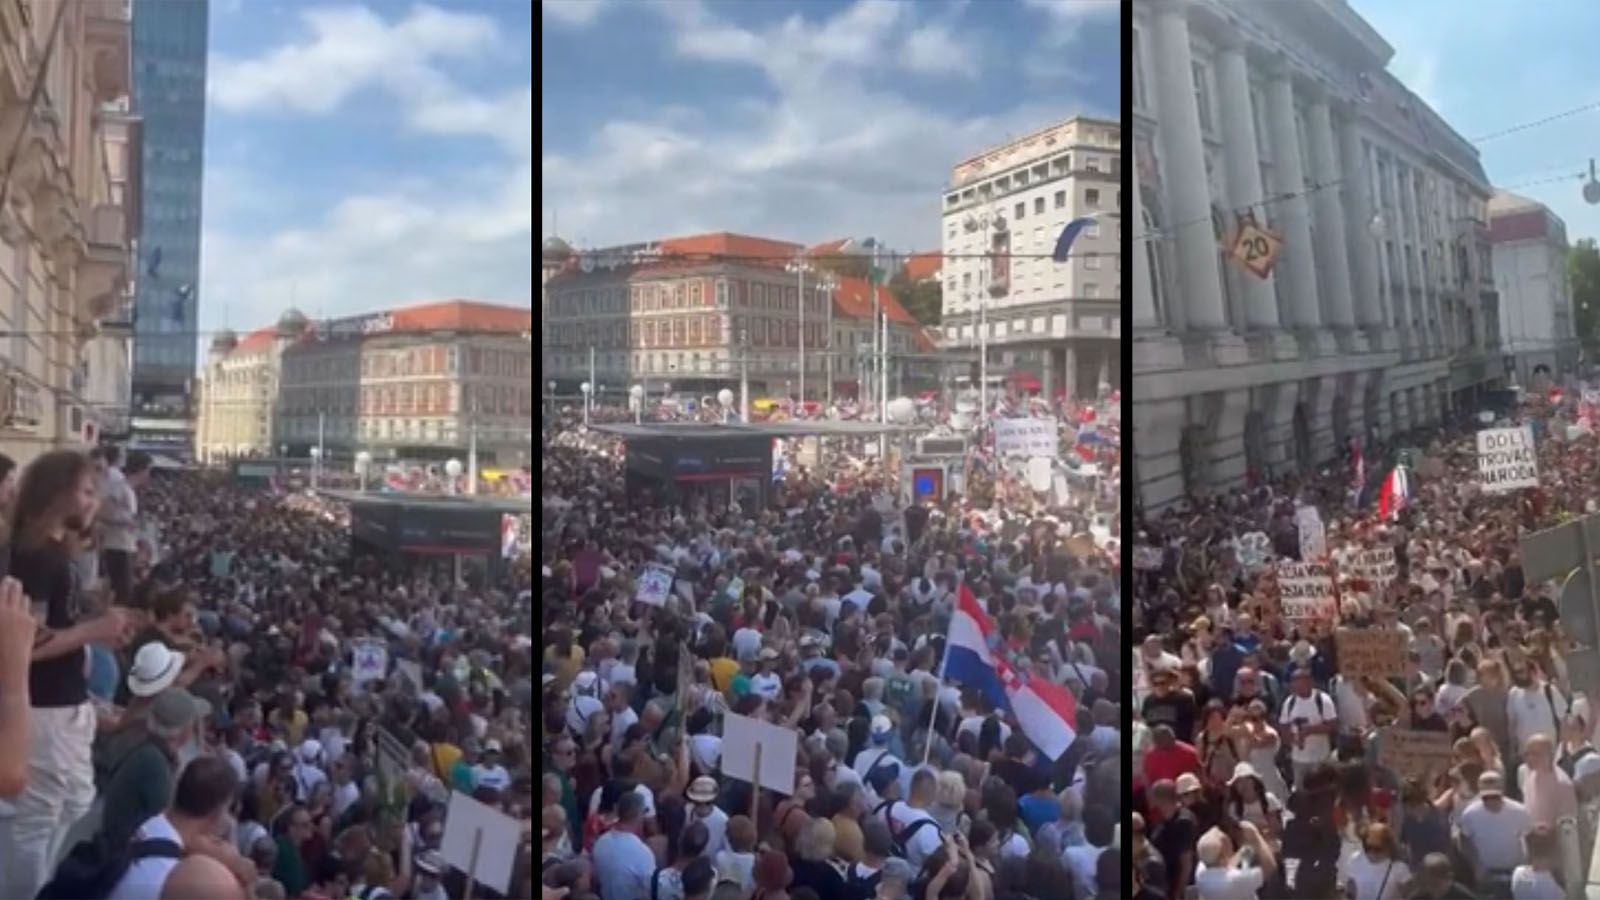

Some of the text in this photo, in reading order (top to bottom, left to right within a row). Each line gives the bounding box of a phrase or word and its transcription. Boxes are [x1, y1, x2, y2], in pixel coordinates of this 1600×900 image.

[1242, 236, 1269, 261] 20
[1486, 431, 1528, 449] DOLI
[1480, 465, 1536, 484] NARODA
